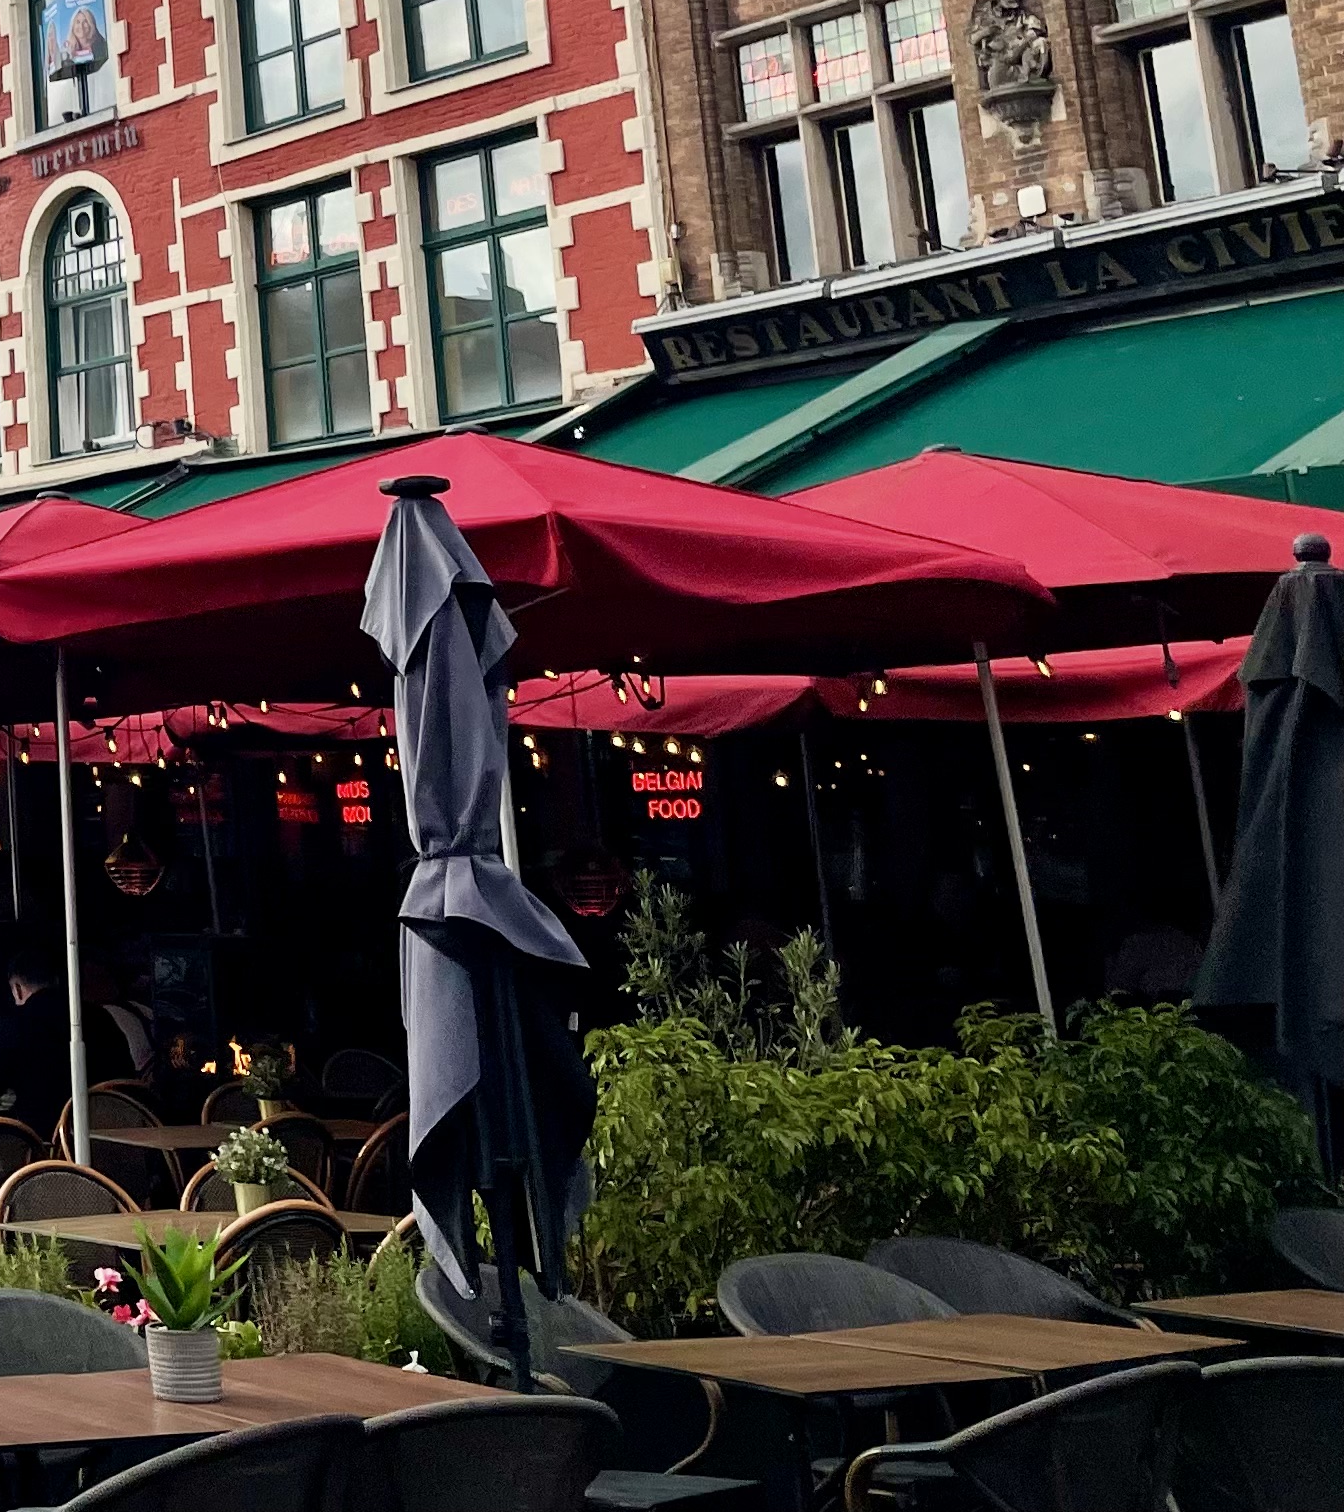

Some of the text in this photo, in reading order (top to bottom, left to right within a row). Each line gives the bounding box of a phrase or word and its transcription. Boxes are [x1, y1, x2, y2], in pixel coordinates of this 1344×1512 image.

[31, 123, 140, 178] meermin
[662, 203, 1344, 370] RESTAURANT LA CIVIE
[647, 798, 702, 820] FOOD
